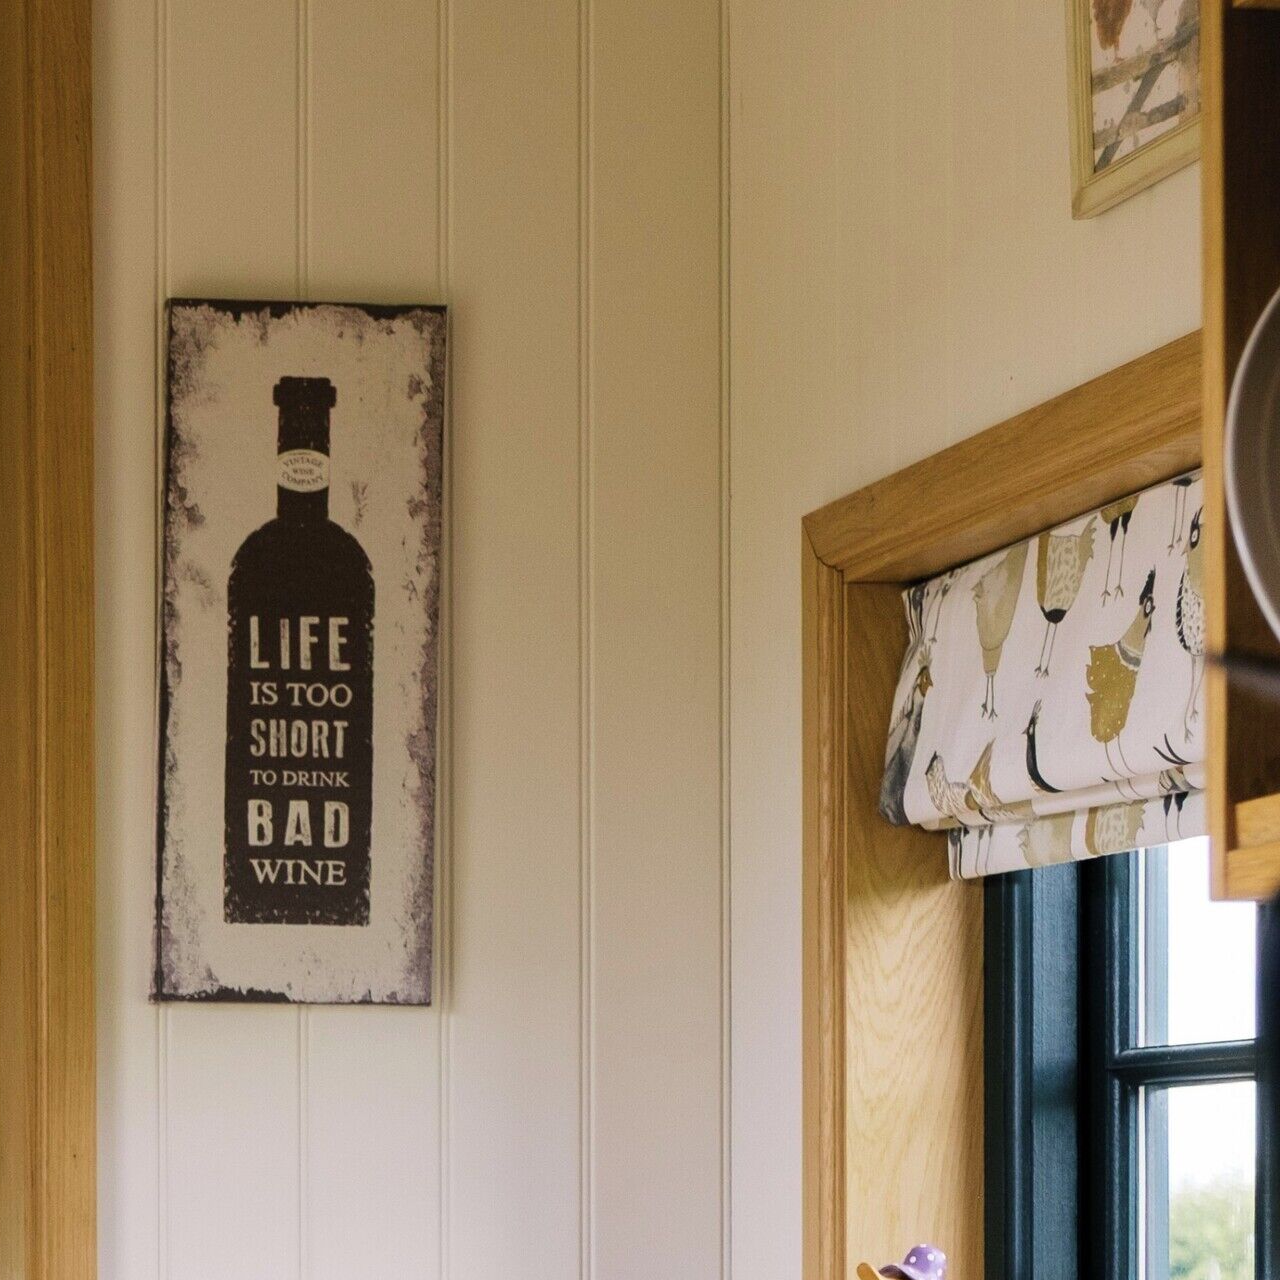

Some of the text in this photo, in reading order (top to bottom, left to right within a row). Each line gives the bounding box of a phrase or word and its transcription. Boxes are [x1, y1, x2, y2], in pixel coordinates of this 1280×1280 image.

[249, 615, 352, 672] LIFE
[249, 682, 354, 708] IS TOO
[249, 718, 350, 759] SHORT
[249, 769, 350, 788] TO DRINK
[247, 799, 351, 849] BAD
[249, 858, 348, 887] WINE
